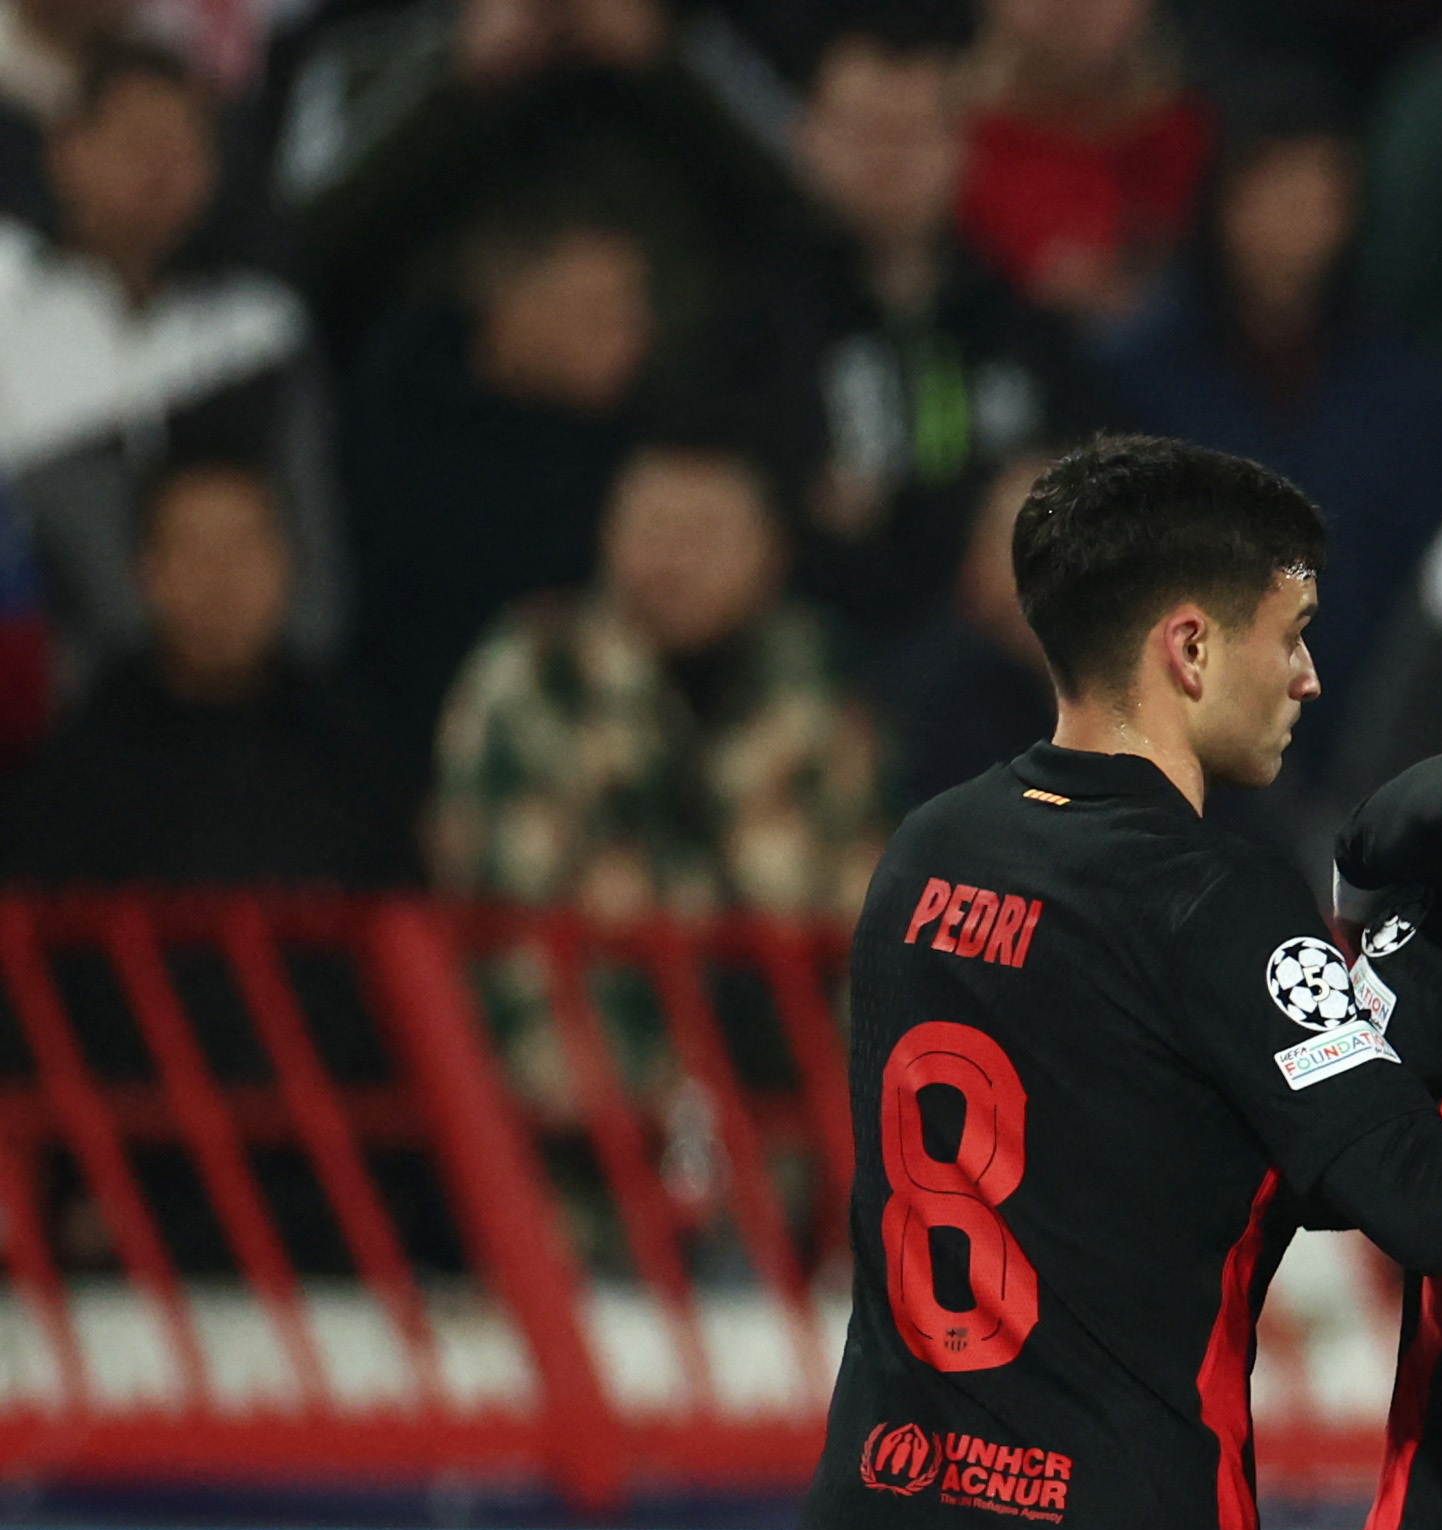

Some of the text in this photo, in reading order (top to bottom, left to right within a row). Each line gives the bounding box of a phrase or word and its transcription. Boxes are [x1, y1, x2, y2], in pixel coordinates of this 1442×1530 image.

[904, 877, 1044, 969] PEDRI
[1302, 965, 1330, 1002] 5
[880, 1019, 1041, 1373] 8
[945, 1432, 1073, 1480] UNHCR
[941, 1463, 1068, 1510] ACNUR
